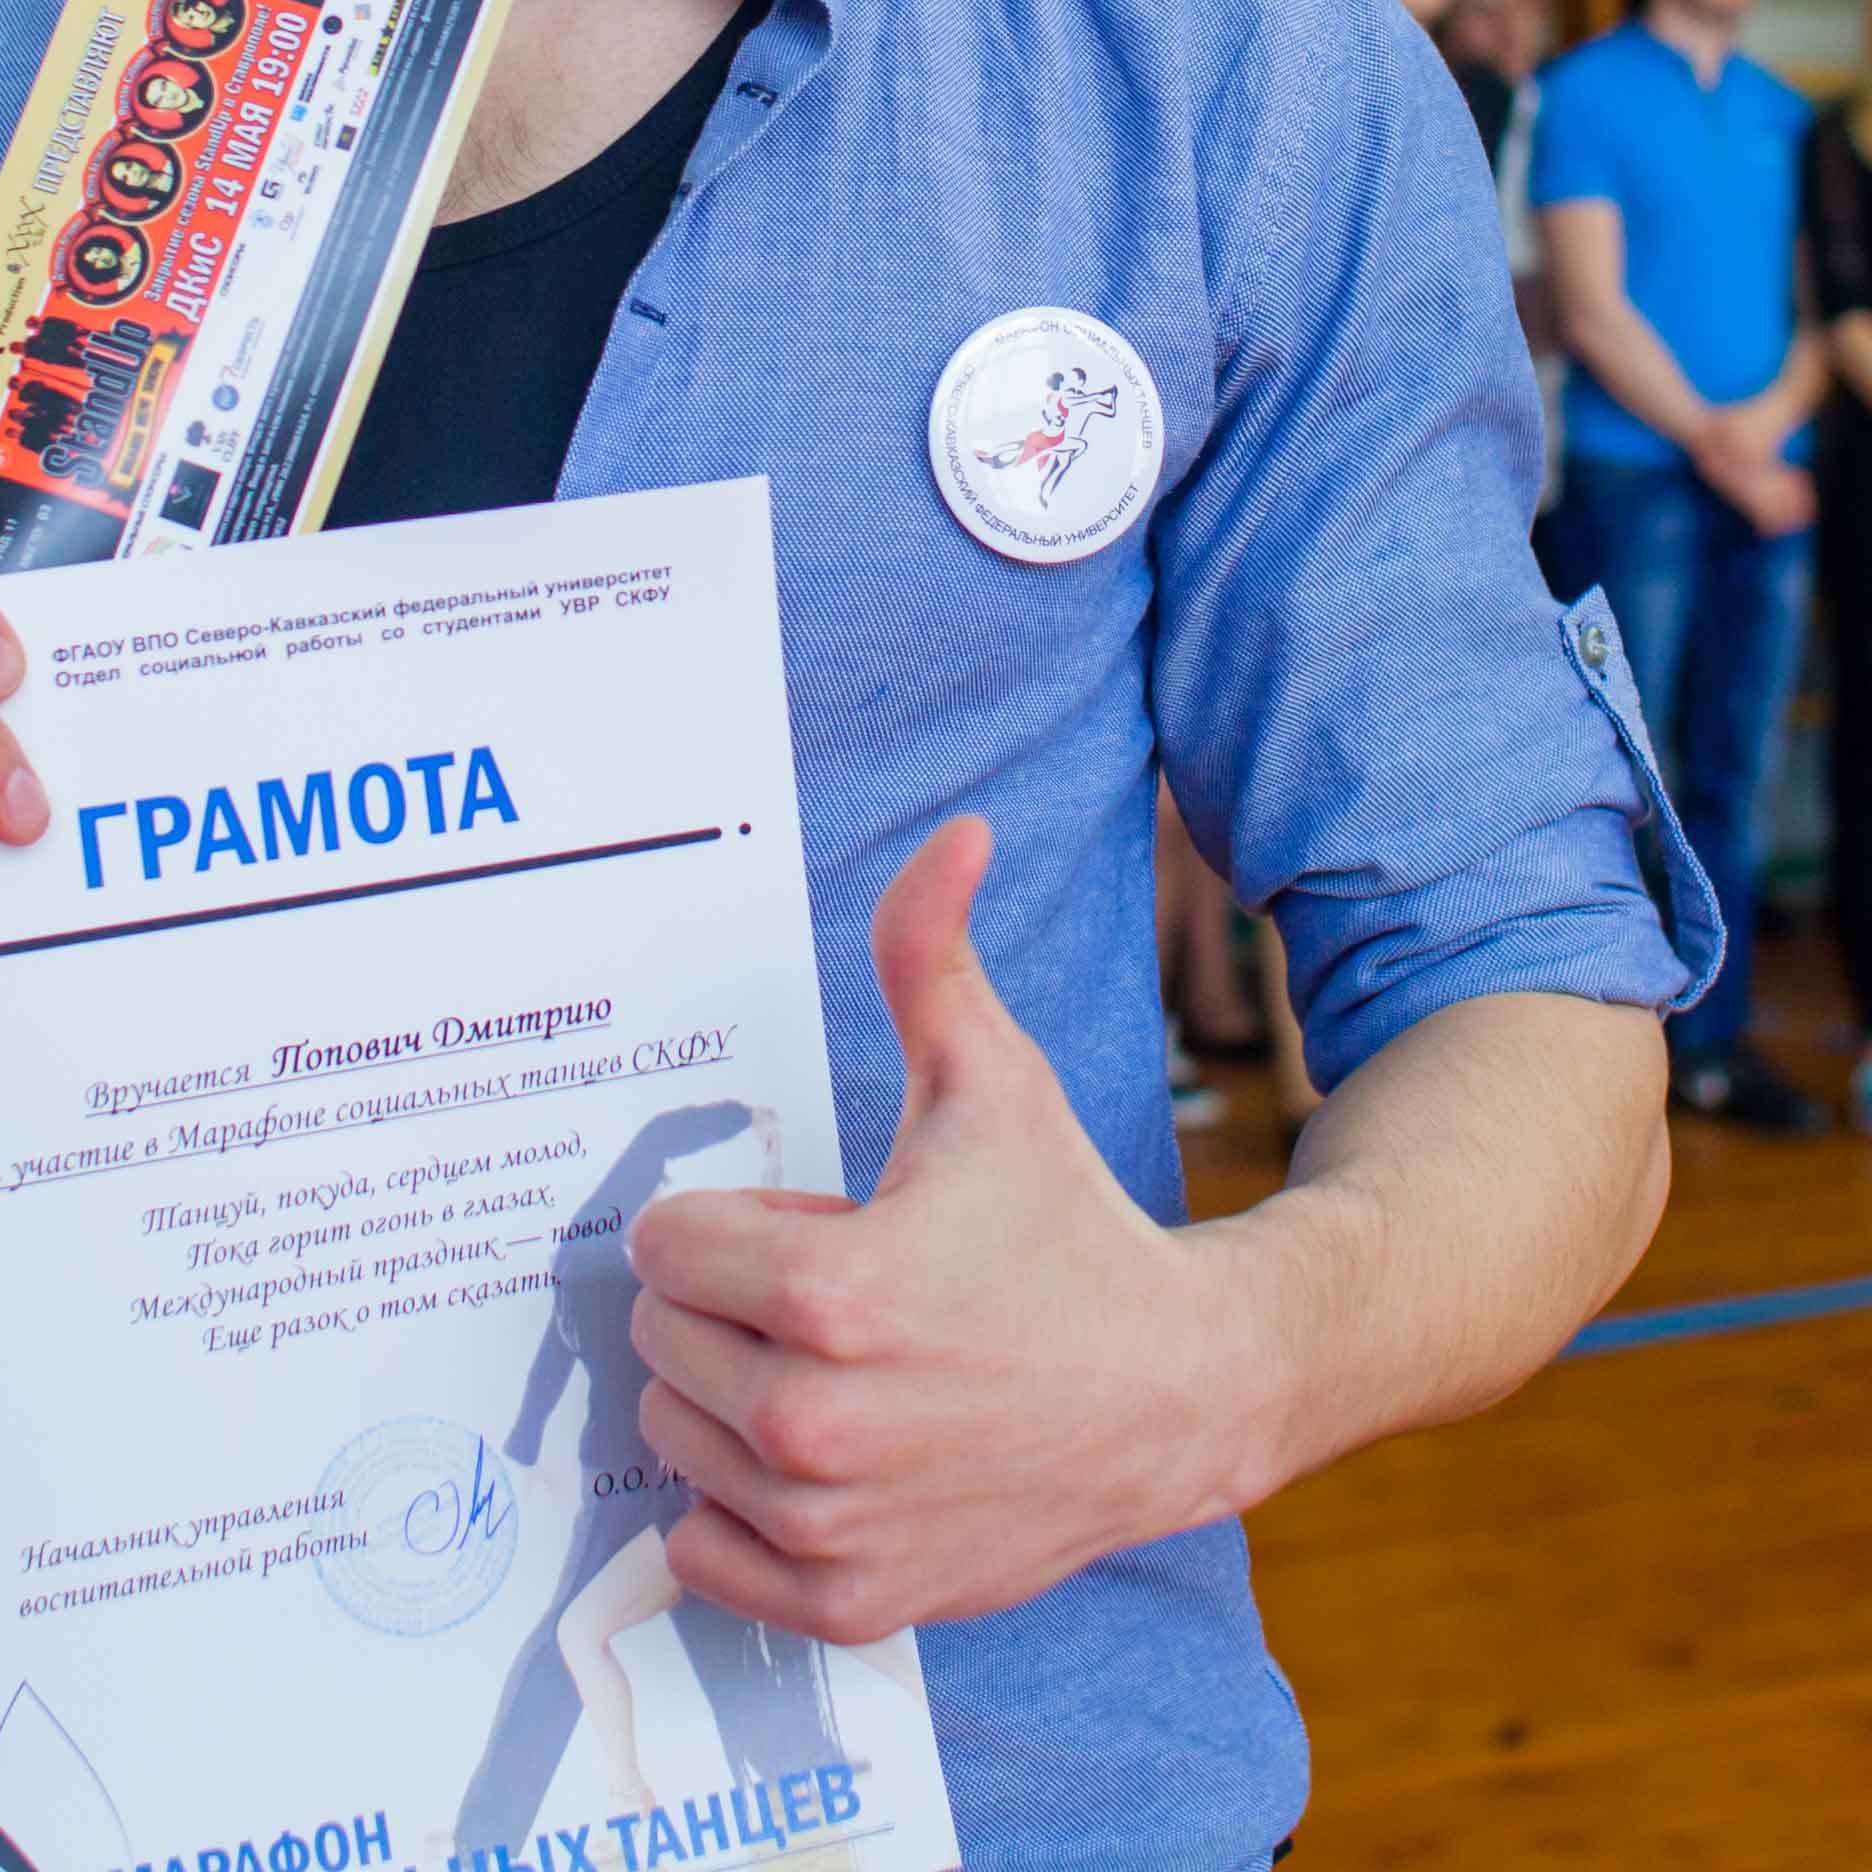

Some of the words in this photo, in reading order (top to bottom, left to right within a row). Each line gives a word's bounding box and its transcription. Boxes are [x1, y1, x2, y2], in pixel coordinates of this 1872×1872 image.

[225, 4, 270, 94] Ставрополе!
[251, 12, 308, 97] 19:00
[33, 6, 125, 194] ПРЕДСТАВЛЯЮТ
[194, 108, 232, 172] StandUp
[222, 97, 235, 107] в
[222, 102, 273, 171] МАЯ
[179, 174, 205, 226] сезона
[206, 175, 244, 217] 14
[144, 228, 186, 302] Закрытие
[165, 232, 223, 323] ДКиС
[40, 318, 152, 486] StandUp
[1135, 390, 1153, 450] ТАНЦЕВ
[974, 502, 1062, 548] ФЕДЕРАЛЬНЫЙ
[1064, 483, 1140, 546] УНИВЕРСИТЕТ
[51, 639, 126, 664] ФГАОУ
[131, 631, 180, 655] ВПО
[184, 601, 387, 646] Северо-Кавказский
[392, 580, 540, 620] федеральный
[544, 565, 673, 600] университет
[53, 667, 121, 689] Отдел
[138, 642, 268, 677] социальной
[285, 631, 363, 660] работы
[380, 626, 406, 642] со
[421, 607, 542, 637] студентами
[559, 594, 601, 617] УВР
[614, 583, 671, 609] СКФУ
[76, 744, 519, 890] ГРАМОТА
[85, 1063, 257, 1119] Вручается
[271, 1031, 424, 1080] Попович
[431, 997, 612, 1058] Дмитрию
[10, 1141, 142, 1192] участие
[144, 1136, 159, 1158] в
[167, 1103, 332, 1161] Марафоне
[335, 1073, 520, 1131] социальных
[519, 1054, 628, 1098] танцев
[631, 1023, 739, 1077] СКФУ
[141, 1191, 266, 1236] Танцуй,
[277, 1172, 376, 1212] покуда,
[386, 1154, 493, 1196] сердцем
[499, 1130, 587, 1170] молод,
[130, 1258, 363, 1325] Международный
[373, 1237, 507, 1285] праздник
[551, 1206, 622, 1243] повод
[187, 1238, 260, 1271] Пока
[268, 1223, 352, 1260] горит
[360, 1208, 433, 1238] огонь
[441, 1204, 455, 1223] в
[201, 1325, 263, 1354] Еще
[271, 1306, 352, 1345] разок
[356, 1304, 371, 1325] о
[379, 1291, 440, 1319] том
[594, 1465, 649, 1497] О.О.
[19, 1549, 253, 1618] воспитательной
[262, 1529, 369, 1577] работы
[21, 1520, 188, 1574] Начальник
[184, 1488, 345, 1550] управления
[606, 1760, 863, 1872] ТАНЦЕВ
